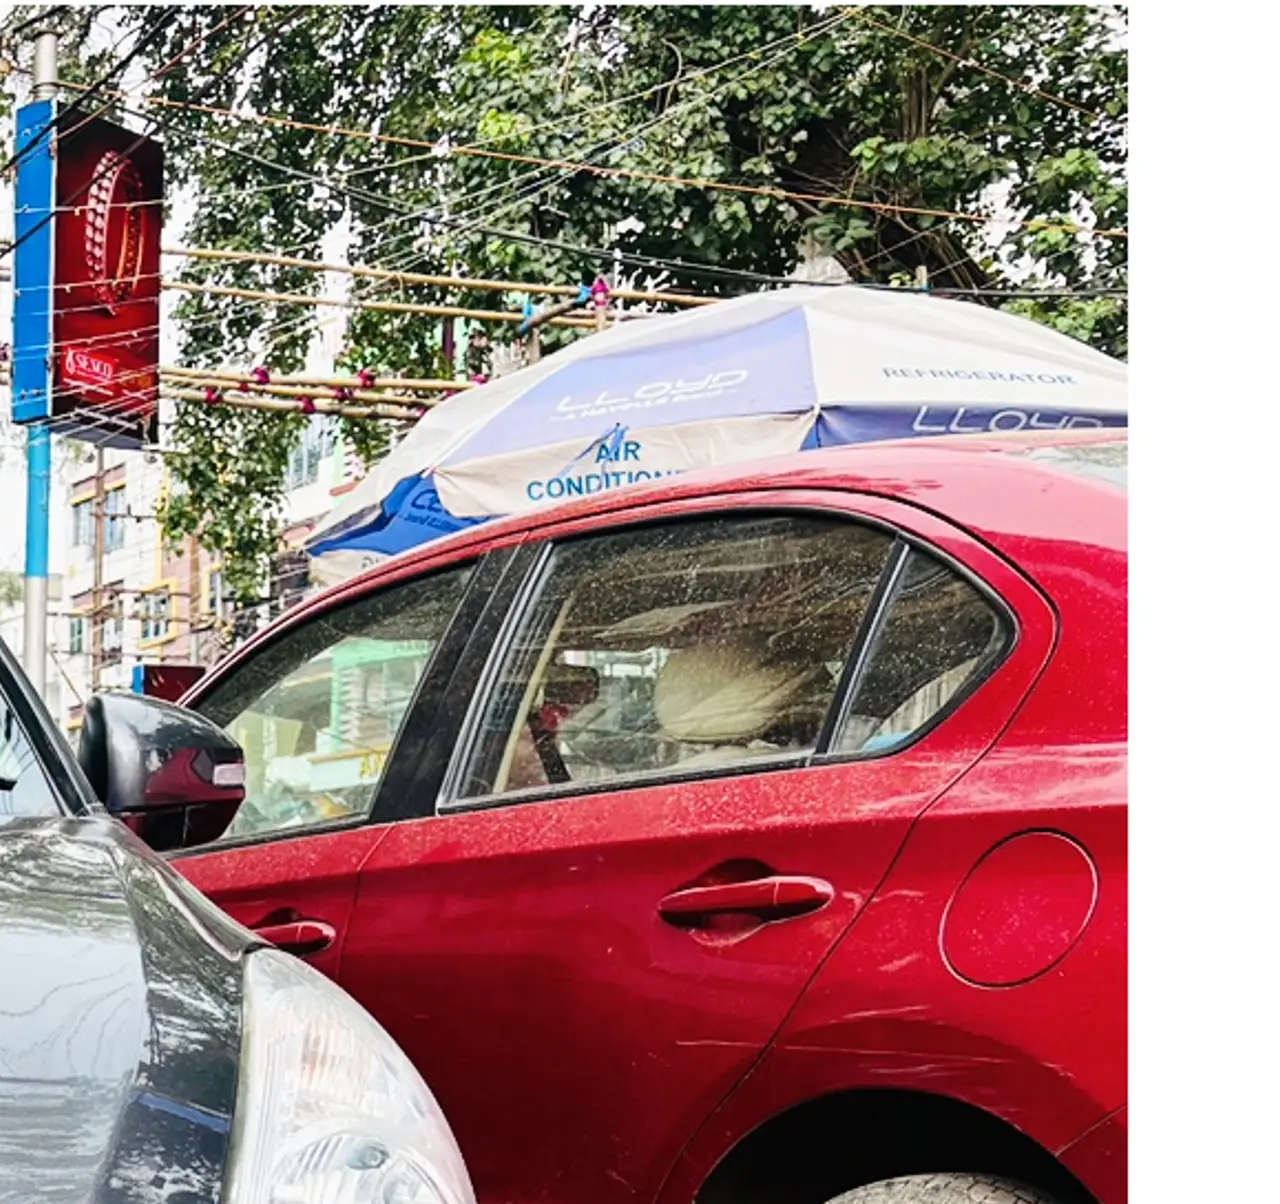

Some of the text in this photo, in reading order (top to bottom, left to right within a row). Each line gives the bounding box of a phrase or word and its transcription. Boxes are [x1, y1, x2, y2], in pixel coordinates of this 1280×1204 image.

[882, 367, 1078, 385] REFRIGERATOR
[555, 369, 748, 413] LLOYD
[595, 441, 641, 463] AIR
